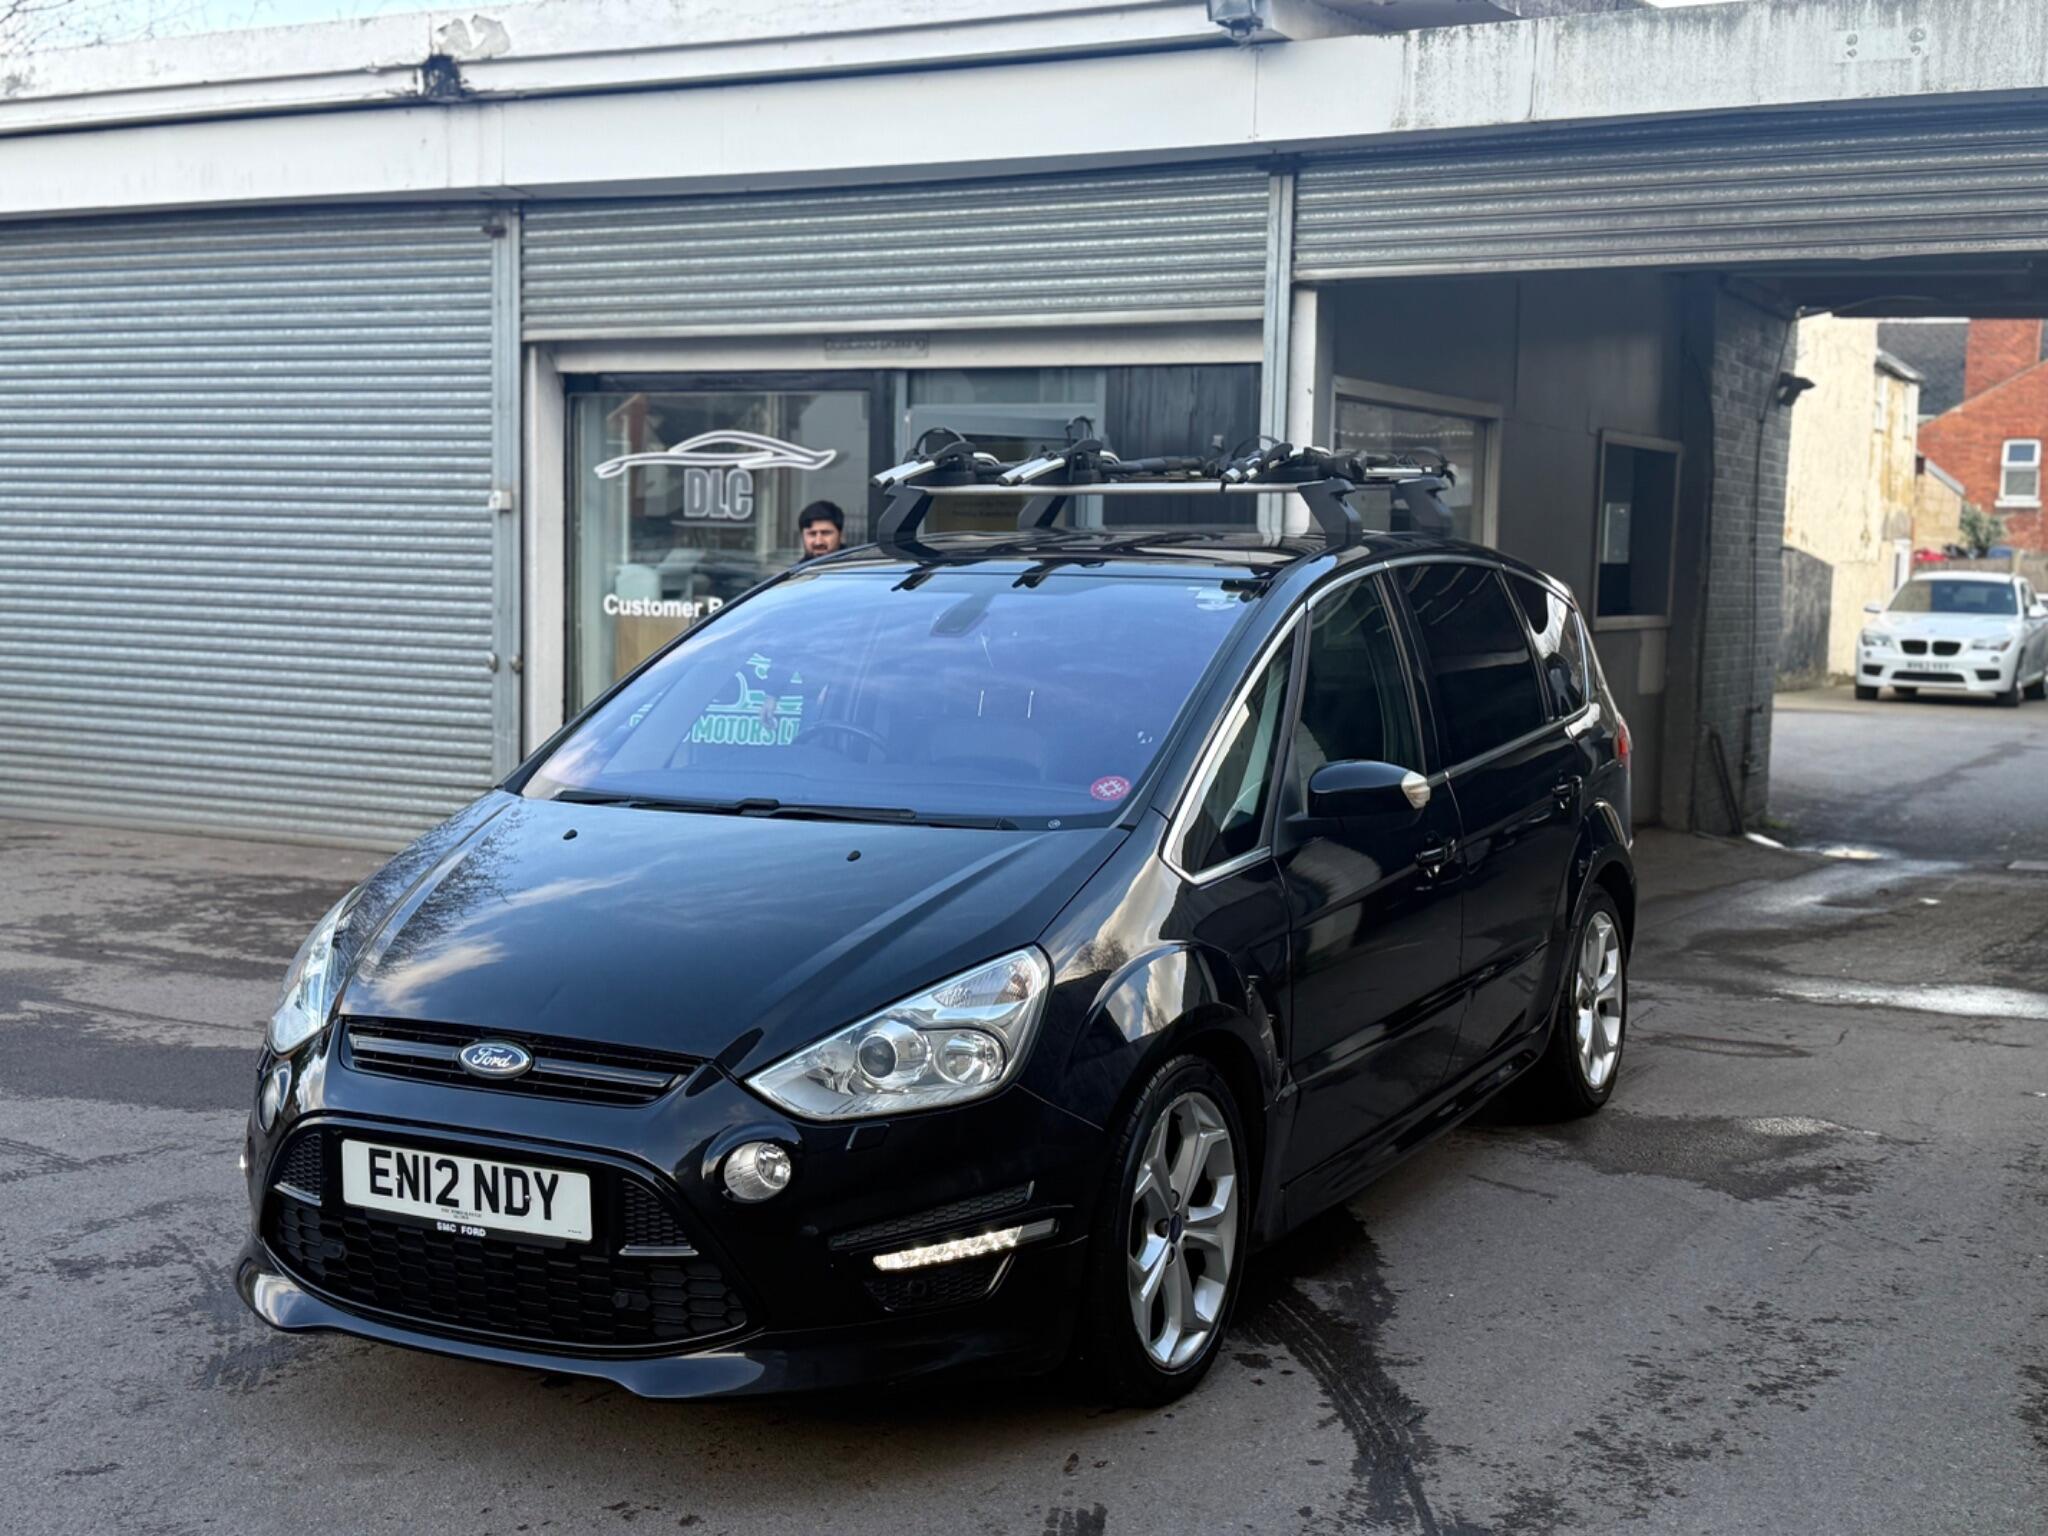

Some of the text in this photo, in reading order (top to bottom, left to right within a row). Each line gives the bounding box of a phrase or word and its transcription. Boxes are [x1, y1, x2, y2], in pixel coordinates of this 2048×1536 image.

[684, 468, 753, 520] DLC
[603, 593, 703, 618] Customer
[692, 714, 778, 745] MOTORS
[472, 1047, 513, 1068] Ford
[473, 1163, 559, 1221] NDY
[436, 1221, 487, 1237] SMC FORD
